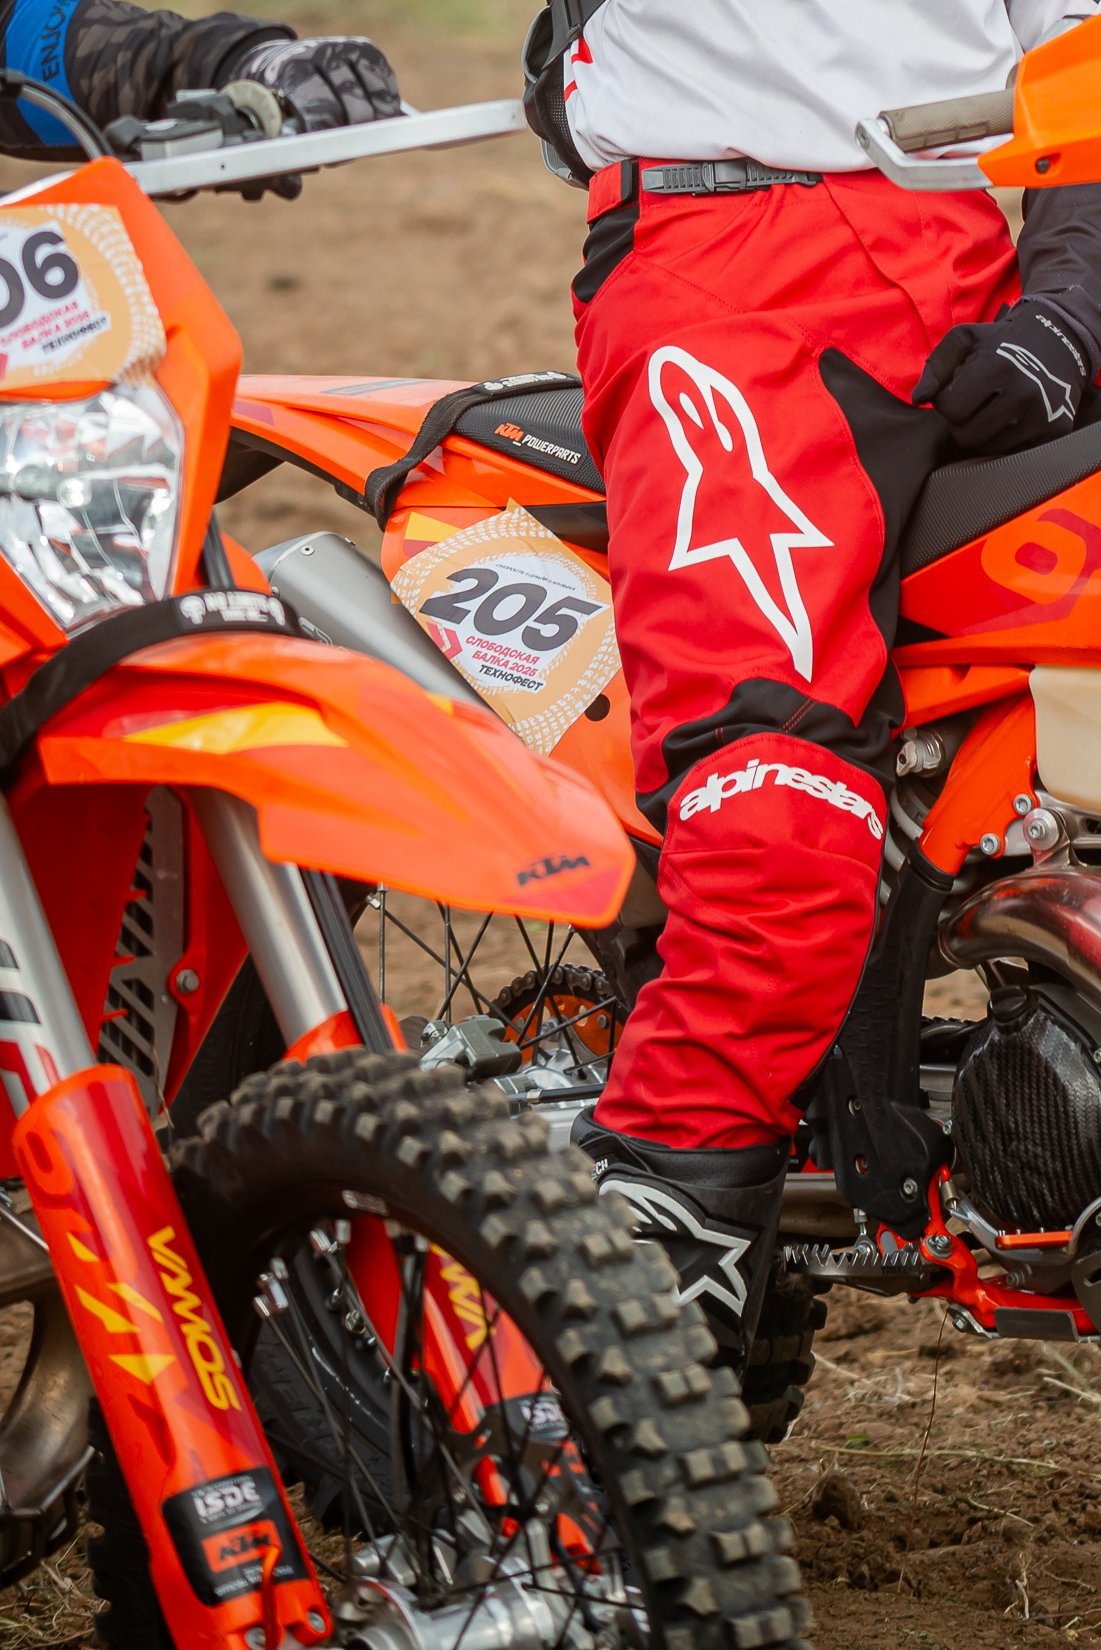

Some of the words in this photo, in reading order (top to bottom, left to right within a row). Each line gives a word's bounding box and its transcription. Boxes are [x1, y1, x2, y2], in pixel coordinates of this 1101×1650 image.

[494, 422, 525, 442] KTM
[522, 434, 582, 465] POWERPARTS
[419, 567, 604, 652] 205
[465, 635, 541, 666] СЛОБОДСКАЯ
[472, 650, 509, 670] БАЛКА
[508, 661, 539, 678] 2025
[478, 664, 544, 692] ТЕХНОФЕСТ
[679, 758, 885, 841] alpinestars
[516, 854, 590, 887] KTM
[147, 1224, 242, 1413] VAMOS
[193, 1480, 261, 1518] ISDE
